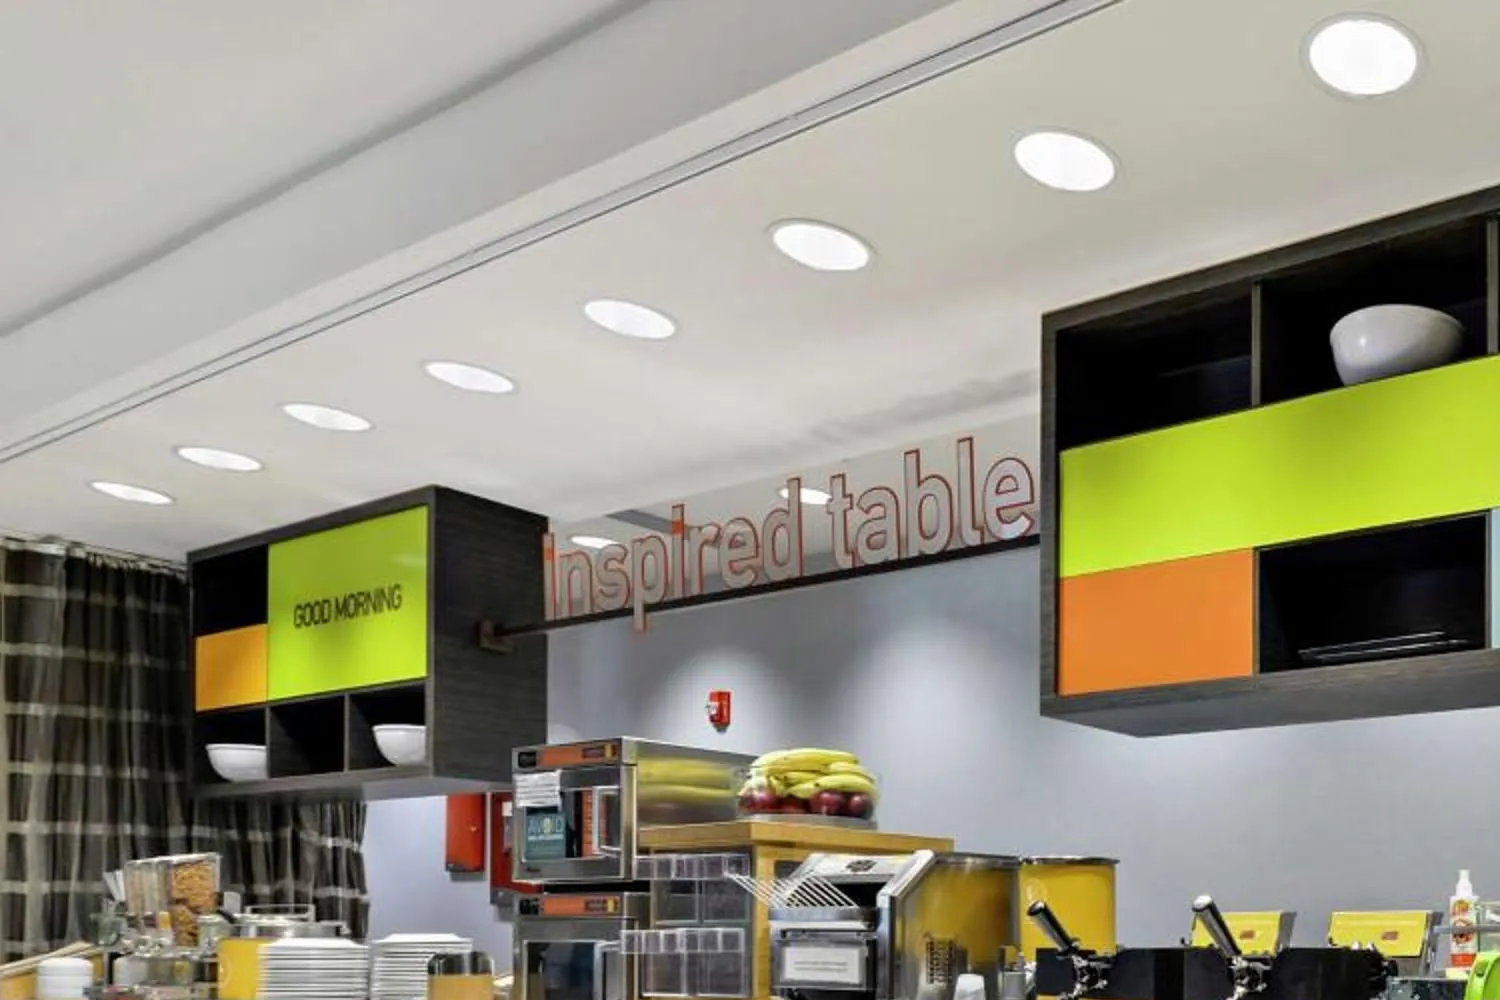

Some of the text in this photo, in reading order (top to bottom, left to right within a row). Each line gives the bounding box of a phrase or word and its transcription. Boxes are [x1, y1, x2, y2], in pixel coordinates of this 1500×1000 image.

[542, 436, 1035, 634] inspired table
[294, 583, 403, 628] GOOD MORNING
